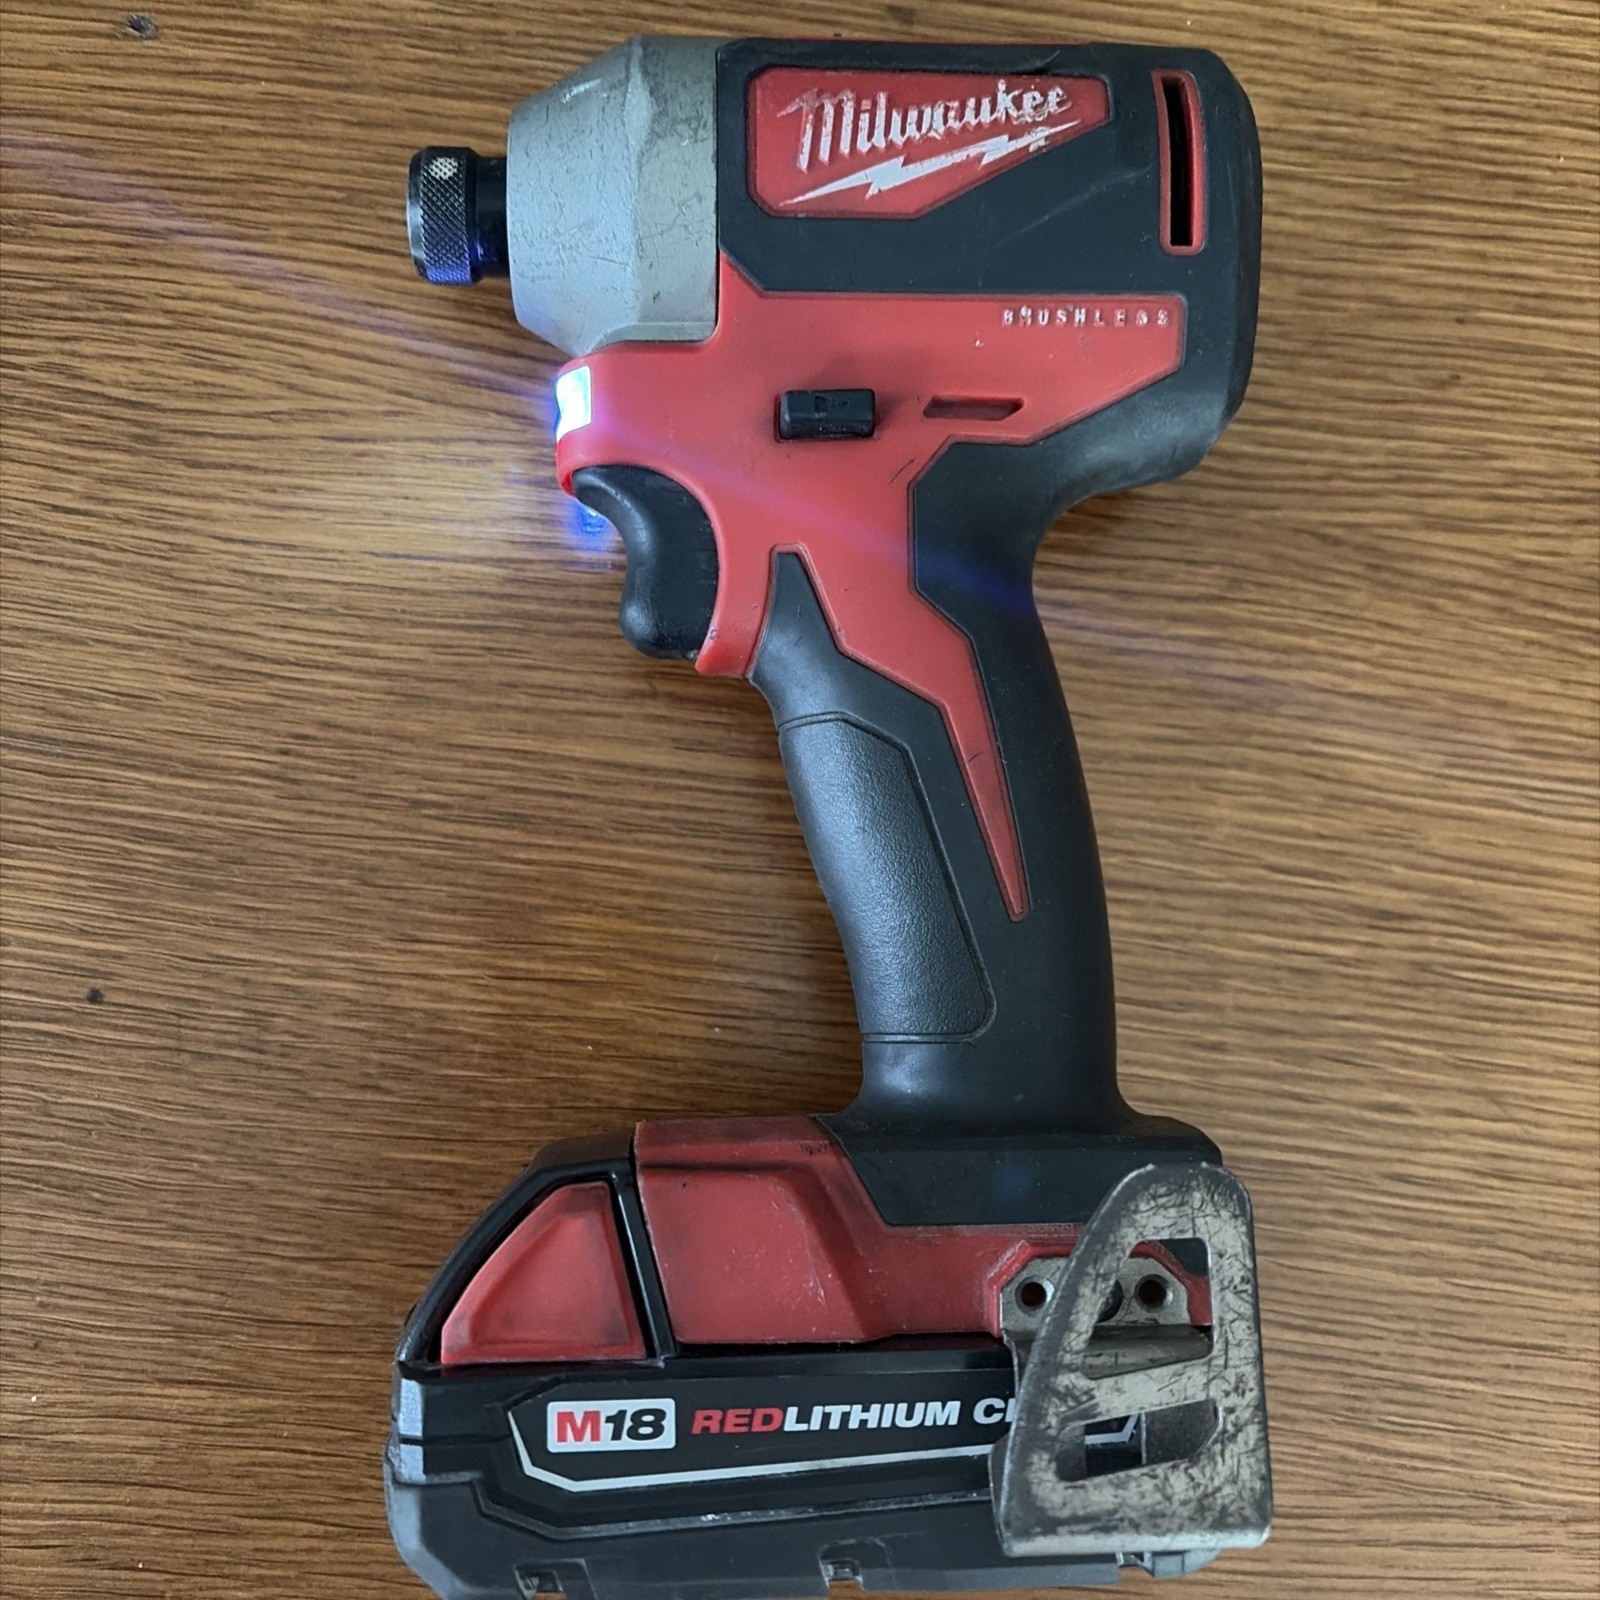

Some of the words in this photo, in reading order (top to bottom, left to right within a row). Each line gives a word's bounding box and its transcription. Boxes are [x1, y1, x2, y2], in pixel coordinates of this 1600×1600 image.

[777, 79, 1073, 173] Milwaukee
[1001, 305, 1169, 327] BRUSHLESS
[556, 1407, 667, 1443] M18
[691, 1400, 962, 1434] REDLITHIUM
